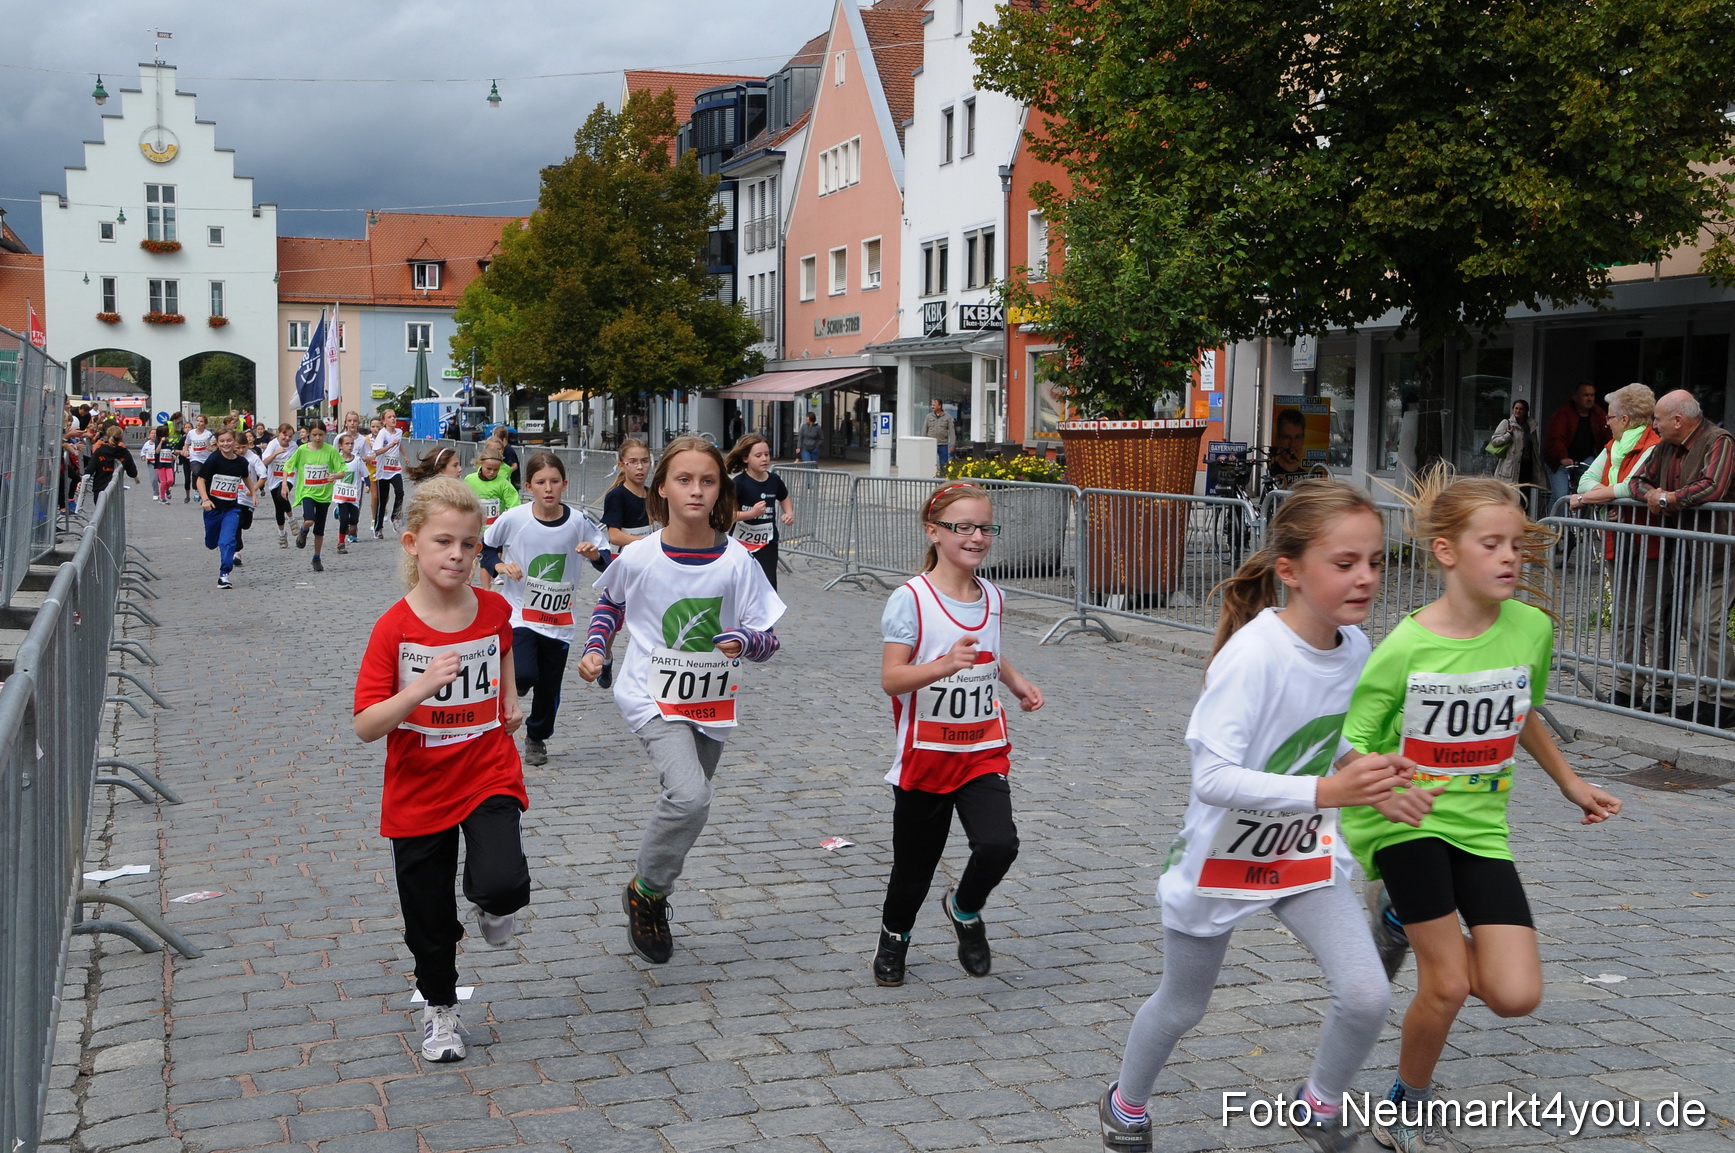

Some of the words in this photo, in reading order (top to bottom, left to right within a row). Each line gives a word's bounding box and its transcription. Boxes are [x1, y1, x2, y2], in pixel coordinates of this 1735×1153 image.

[925, 303, 943, 322] KBK
[963, 307, 1003, 320] KBK
[883, 417, 889, 427] P
[307, 470, 327, 479] 7277
[215, 480, 237, 492] 7275
[337, 487, 355, 497] 7010
[739, 528, 769, 544] 7299
[526, 581, 547, 591] PARTL
[530, 590, 571, 612] 7009
[402, 652, 434, 664] PART
[460, 650, 485, 662] markt
[651, 656, 684, 667] PARTL
[686, 660, 729, 668] Neumarkt
[659, 669, 730, 700] 7011
[956, 673, 992, 683] Neumarkt
[1410, 684, 1455, 695] PARTL
[1457, 680, 1513, 695] Neumarkt
[929, 684, 994, 719] 7013
[431, 709, 475, 725] Marie
[1421, 695, 1516, 737] 7004
[941, 727, 985, 741] Tamara
[1433, 746, 1498, 764] Victoria
[1226, 814, 1323, 857] 7008
[1244, 866, 1280, 885] Mia
